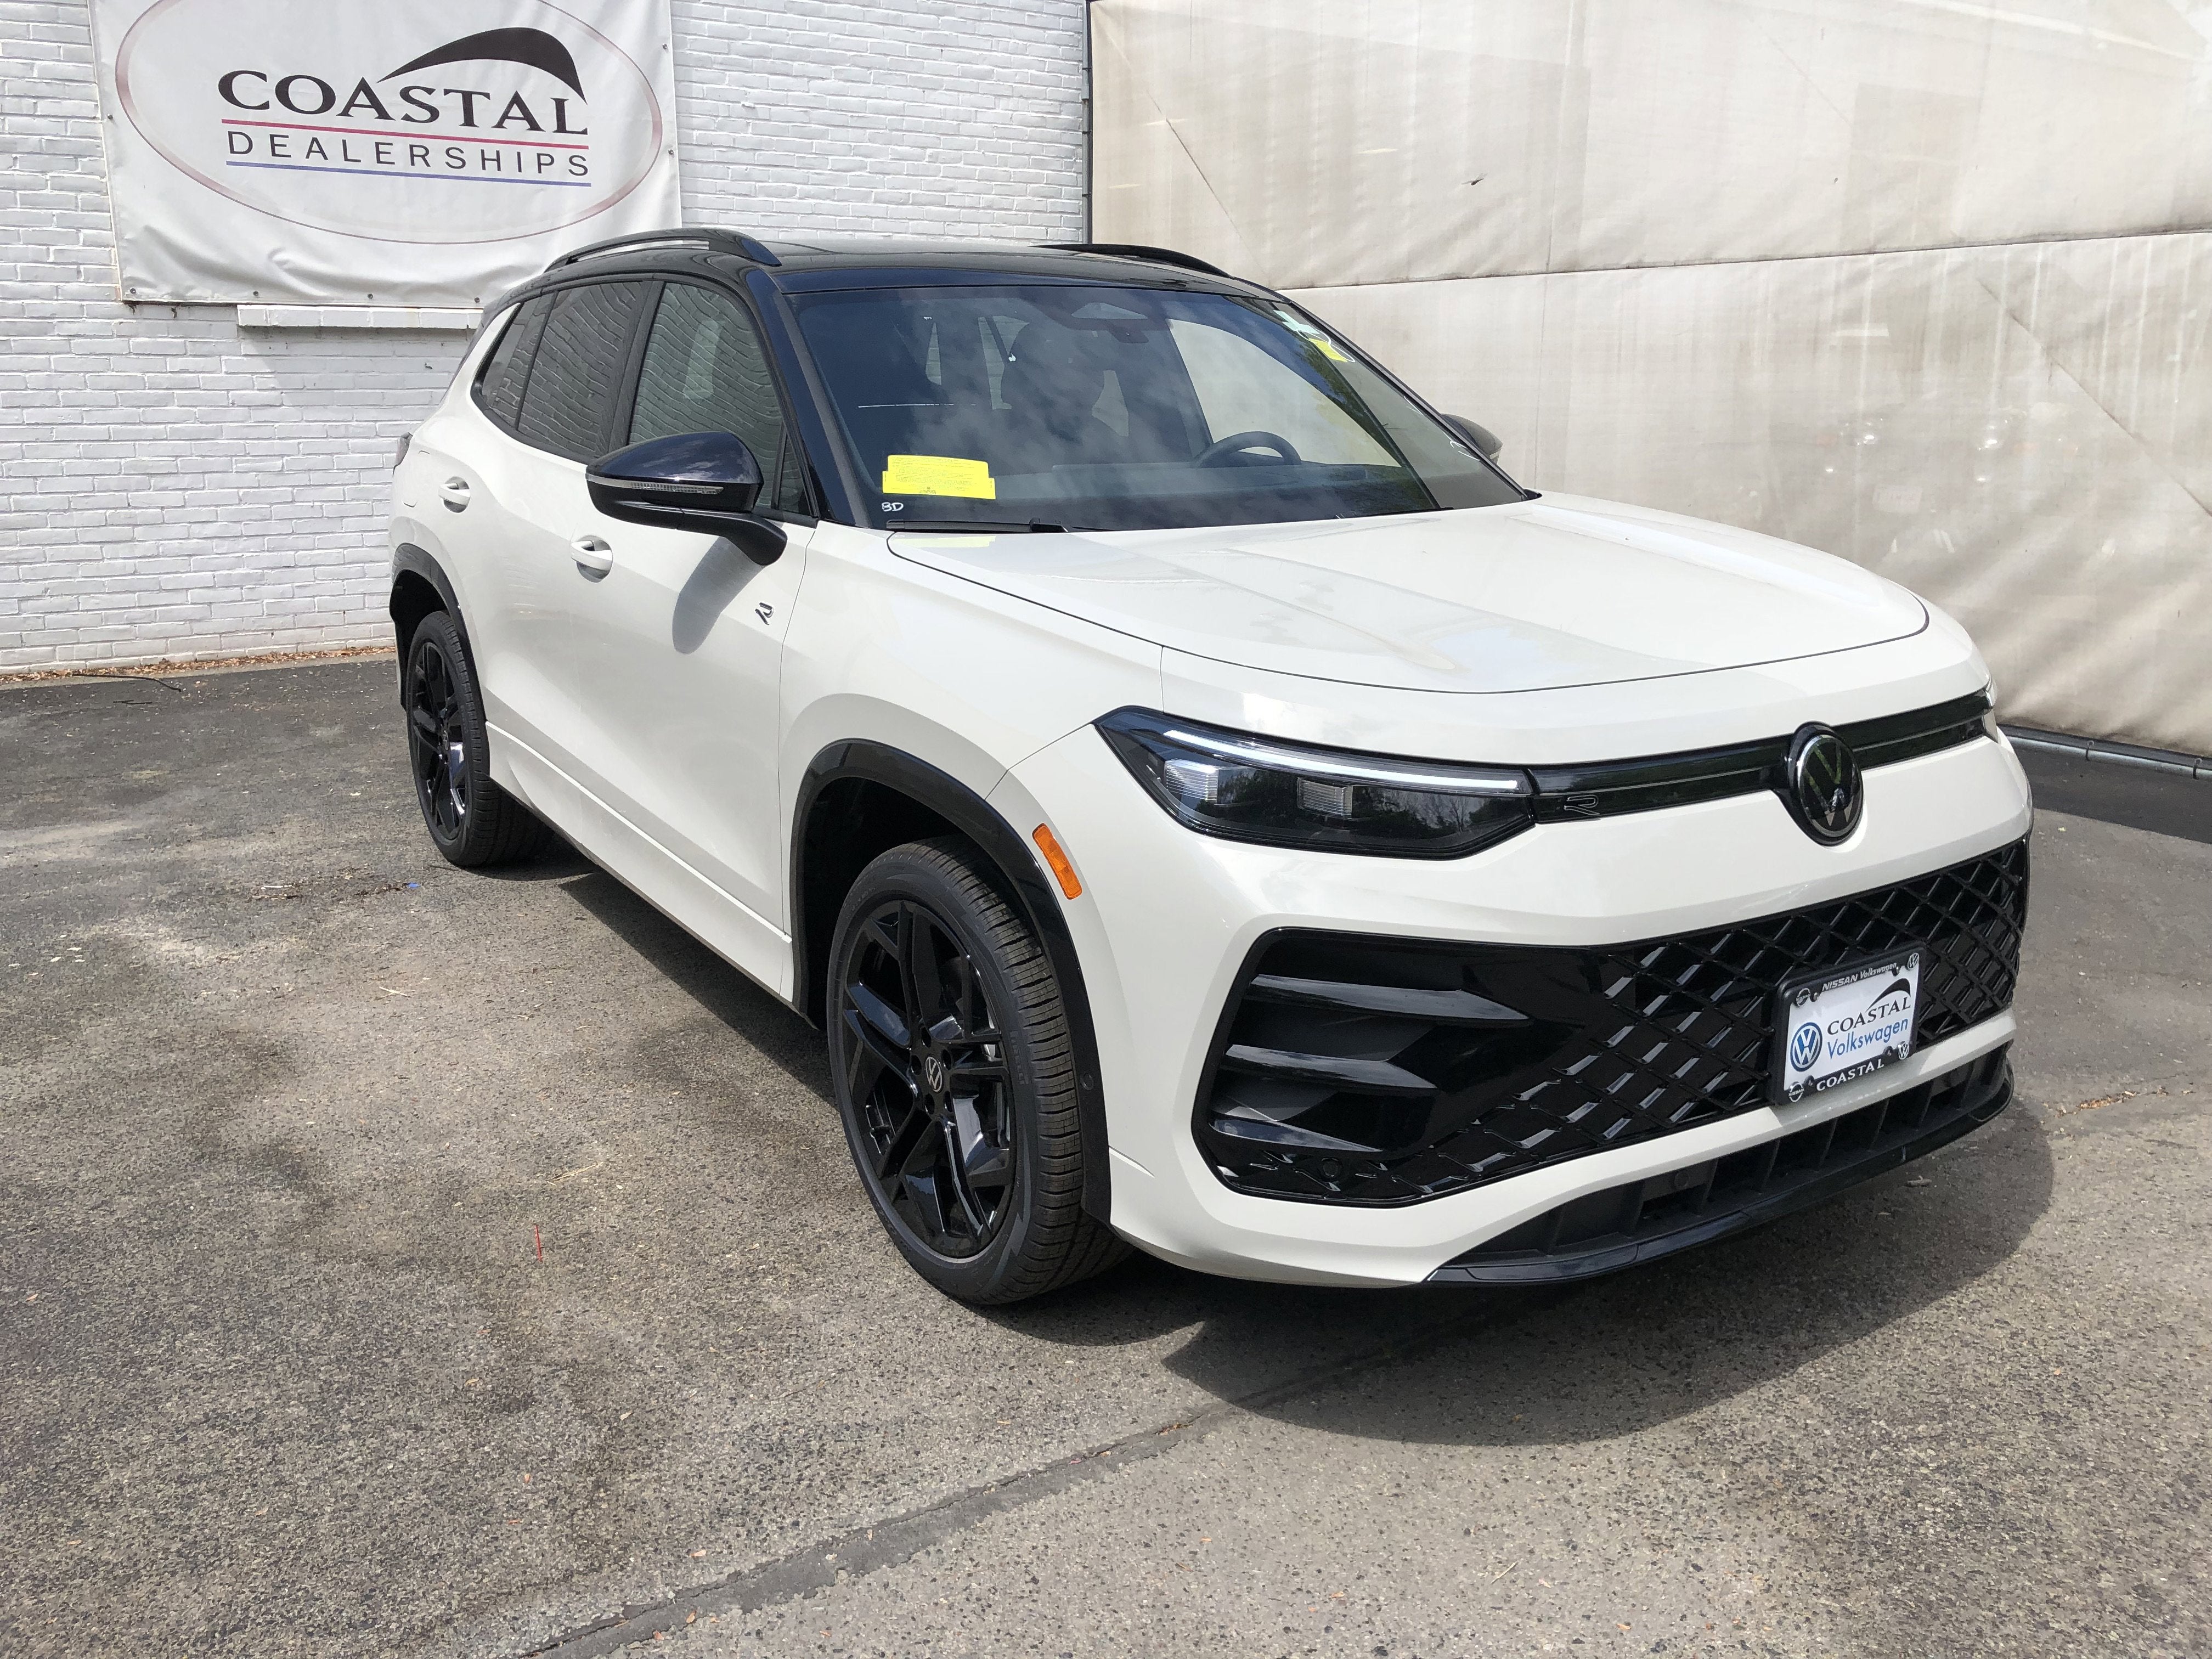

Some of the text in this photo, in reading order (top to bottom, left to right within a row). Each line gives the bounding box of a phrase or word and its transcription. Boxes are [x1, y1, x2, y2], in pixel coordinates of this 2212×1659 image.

[218, 70, 589, 136] COASTAL
[227, 131, 589, 177] DEALERSHIPS
[1822, 962, 1897, 991] NISSAN Volkswagen
[1827, 996, 1911, 1035] COASTAL
[1827, 1018, 1908, 1059] Volkswagen
[1816, 1059, 1884, 1091] COASTAL
